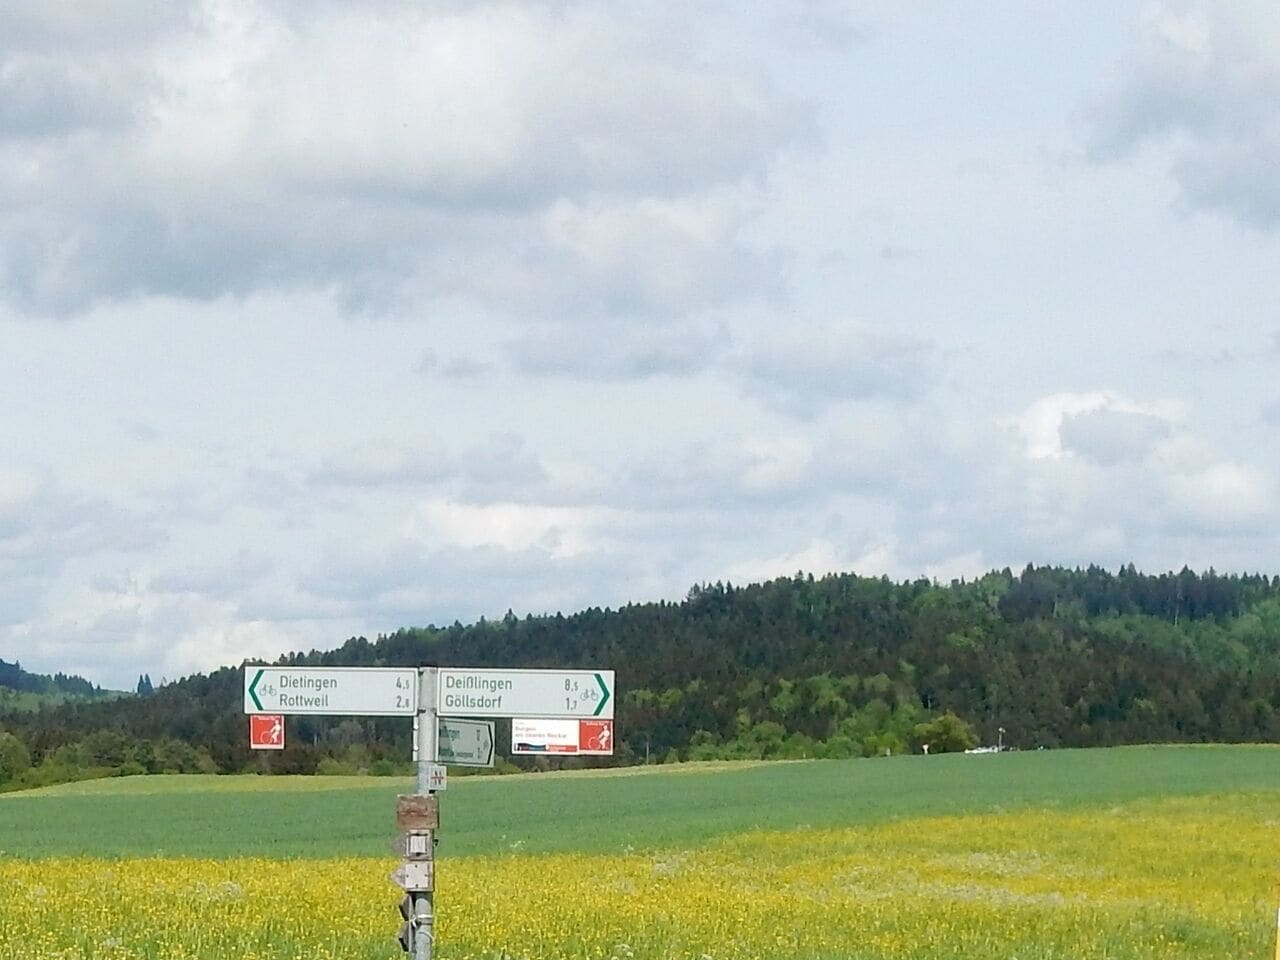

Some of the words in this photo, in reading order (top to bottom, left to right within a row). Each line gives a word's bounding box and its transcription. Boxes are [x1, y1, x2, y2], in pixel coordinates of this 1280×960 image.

[280, 675, 337, 691] Dietingen
[446, 676, 512, 692] Deißlingen
[280, 693, 329, 707] Rottweil
[445, 694, 502, 708] Göllsdorf
